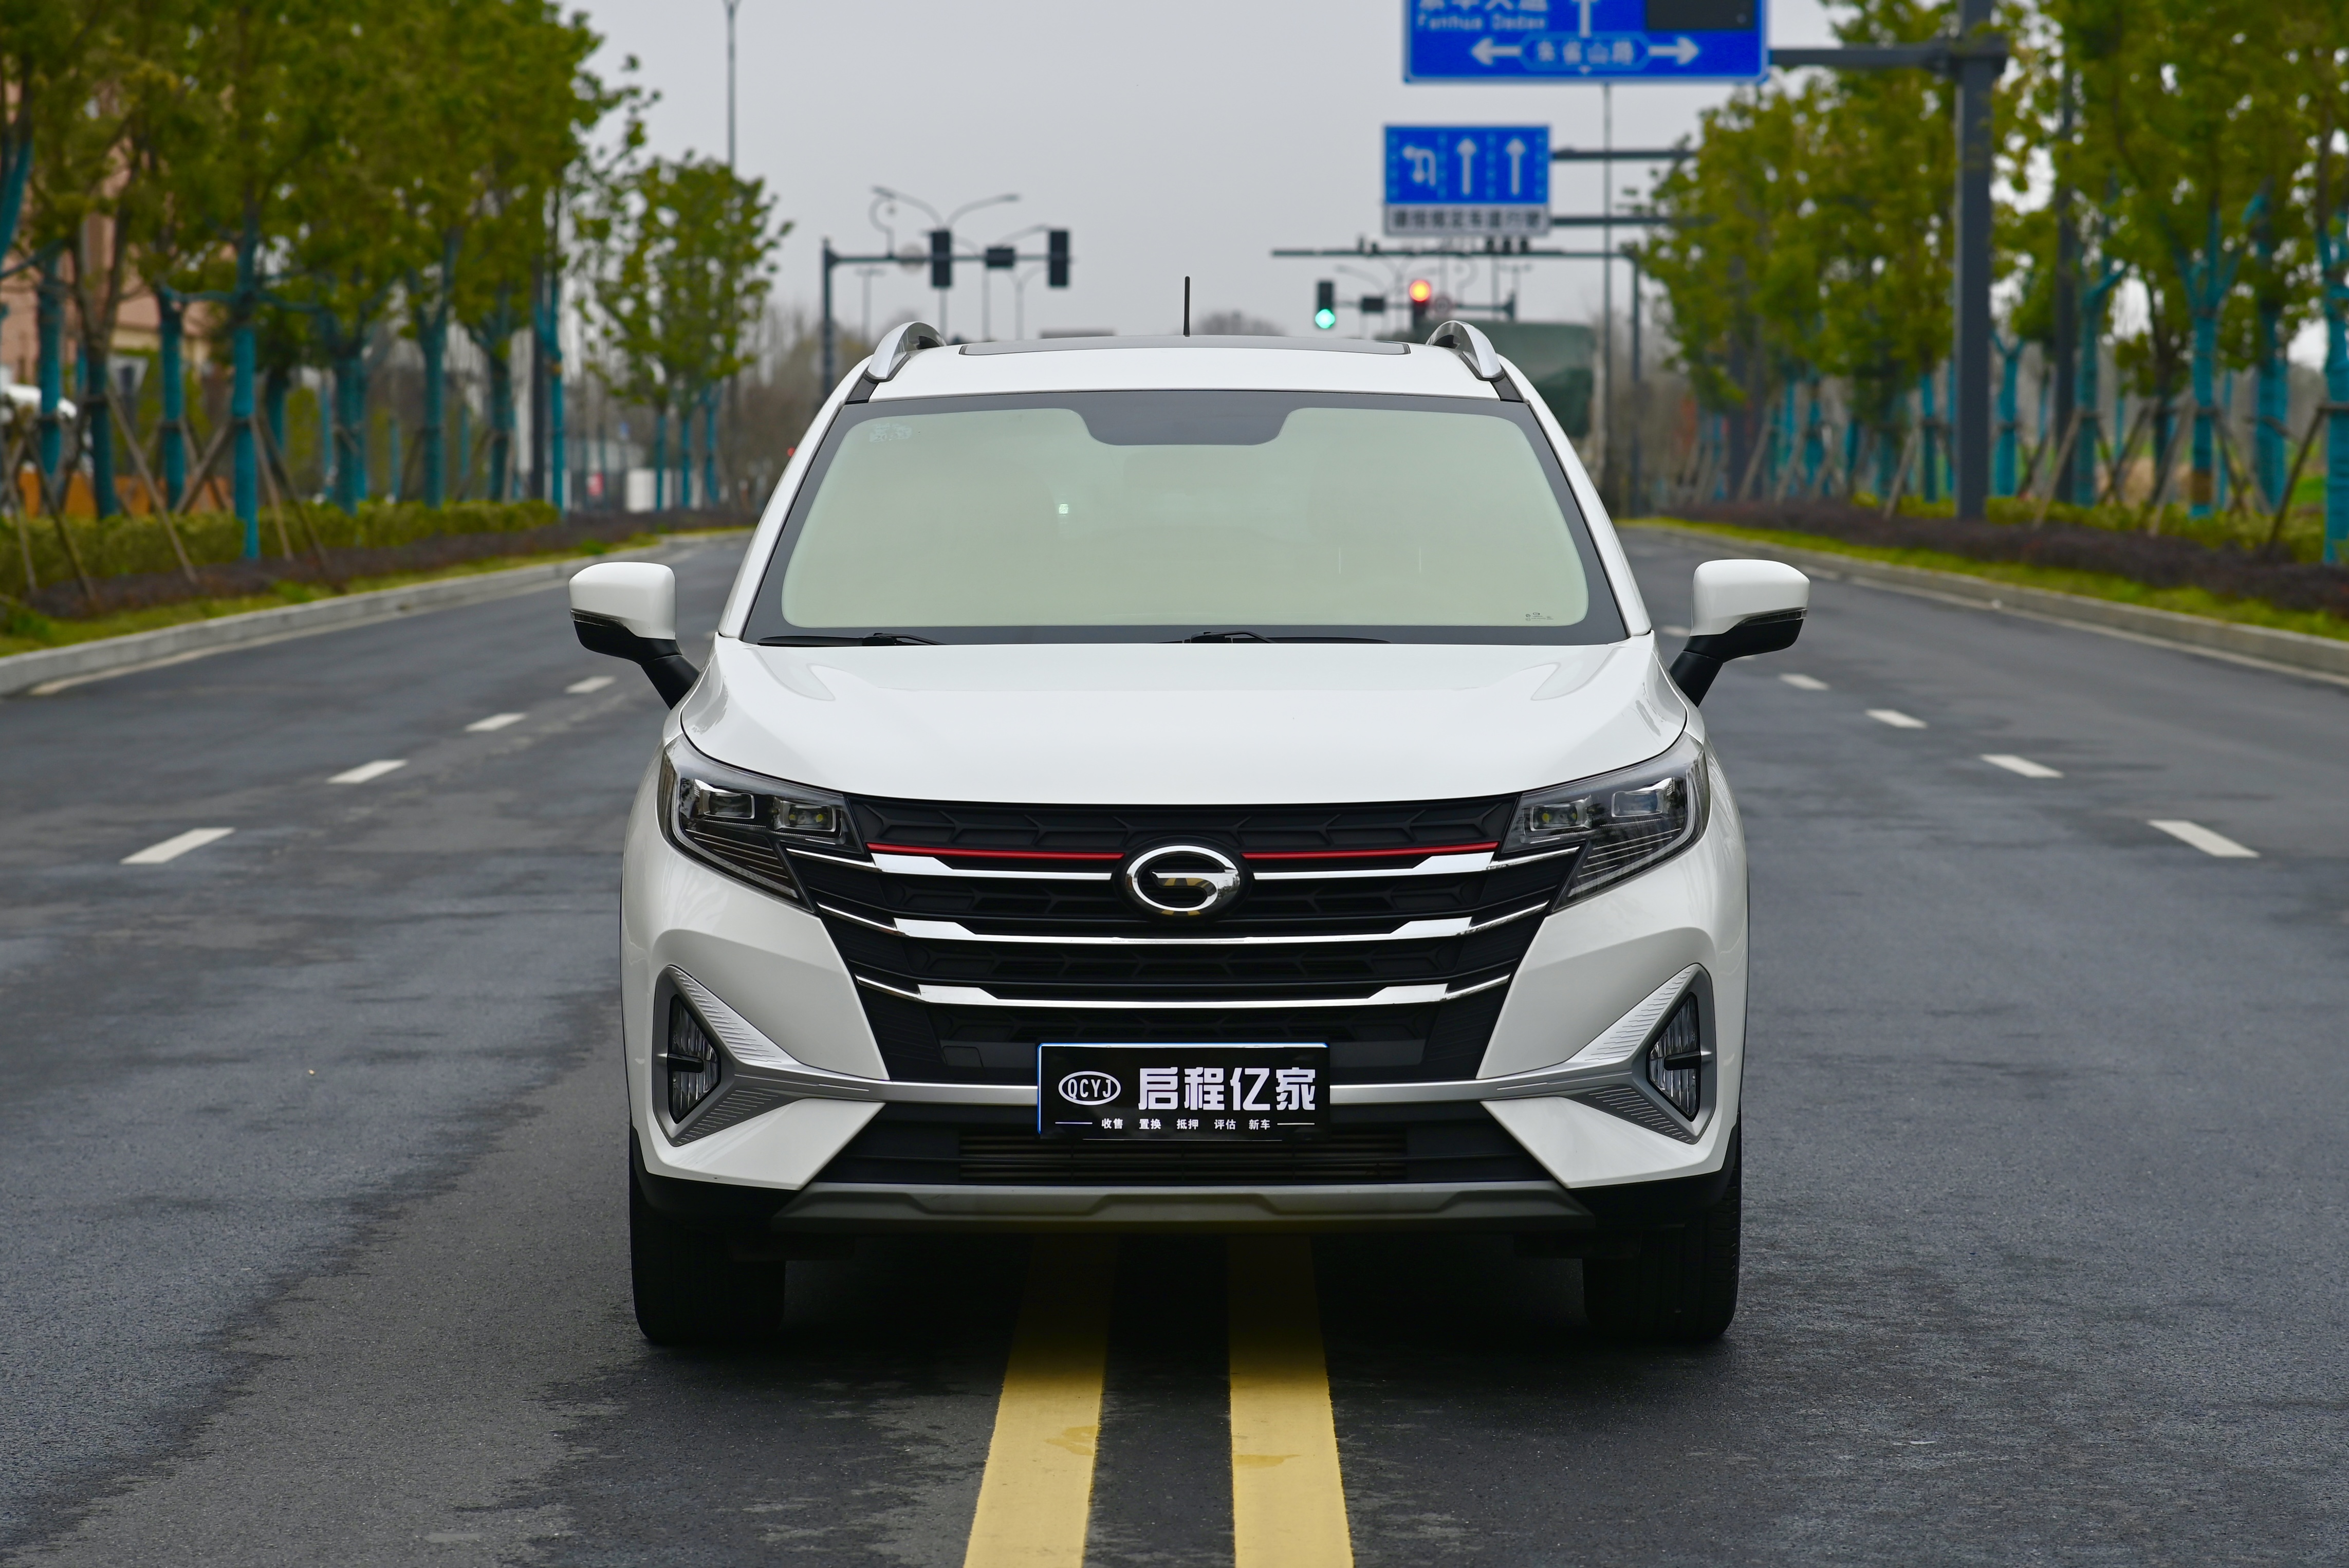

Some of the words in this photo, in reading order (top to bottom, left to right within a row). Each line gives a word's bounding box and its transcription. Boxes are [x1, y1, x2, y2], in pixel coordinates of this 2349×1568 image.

[1068, 1078, 1112, 1100] QCYJ
[1138, 1066, 1316, 1111] 启程亿家
[1101, 1118, 1123, 1130] 收售
[1139, 1118, 1161, 1130] 置换
[1176, 1119, 1199, 1130] 抵押
[1214, 1119, 1236, 1130] 评估
[1248, 1119, 1271, 1130] 新车
